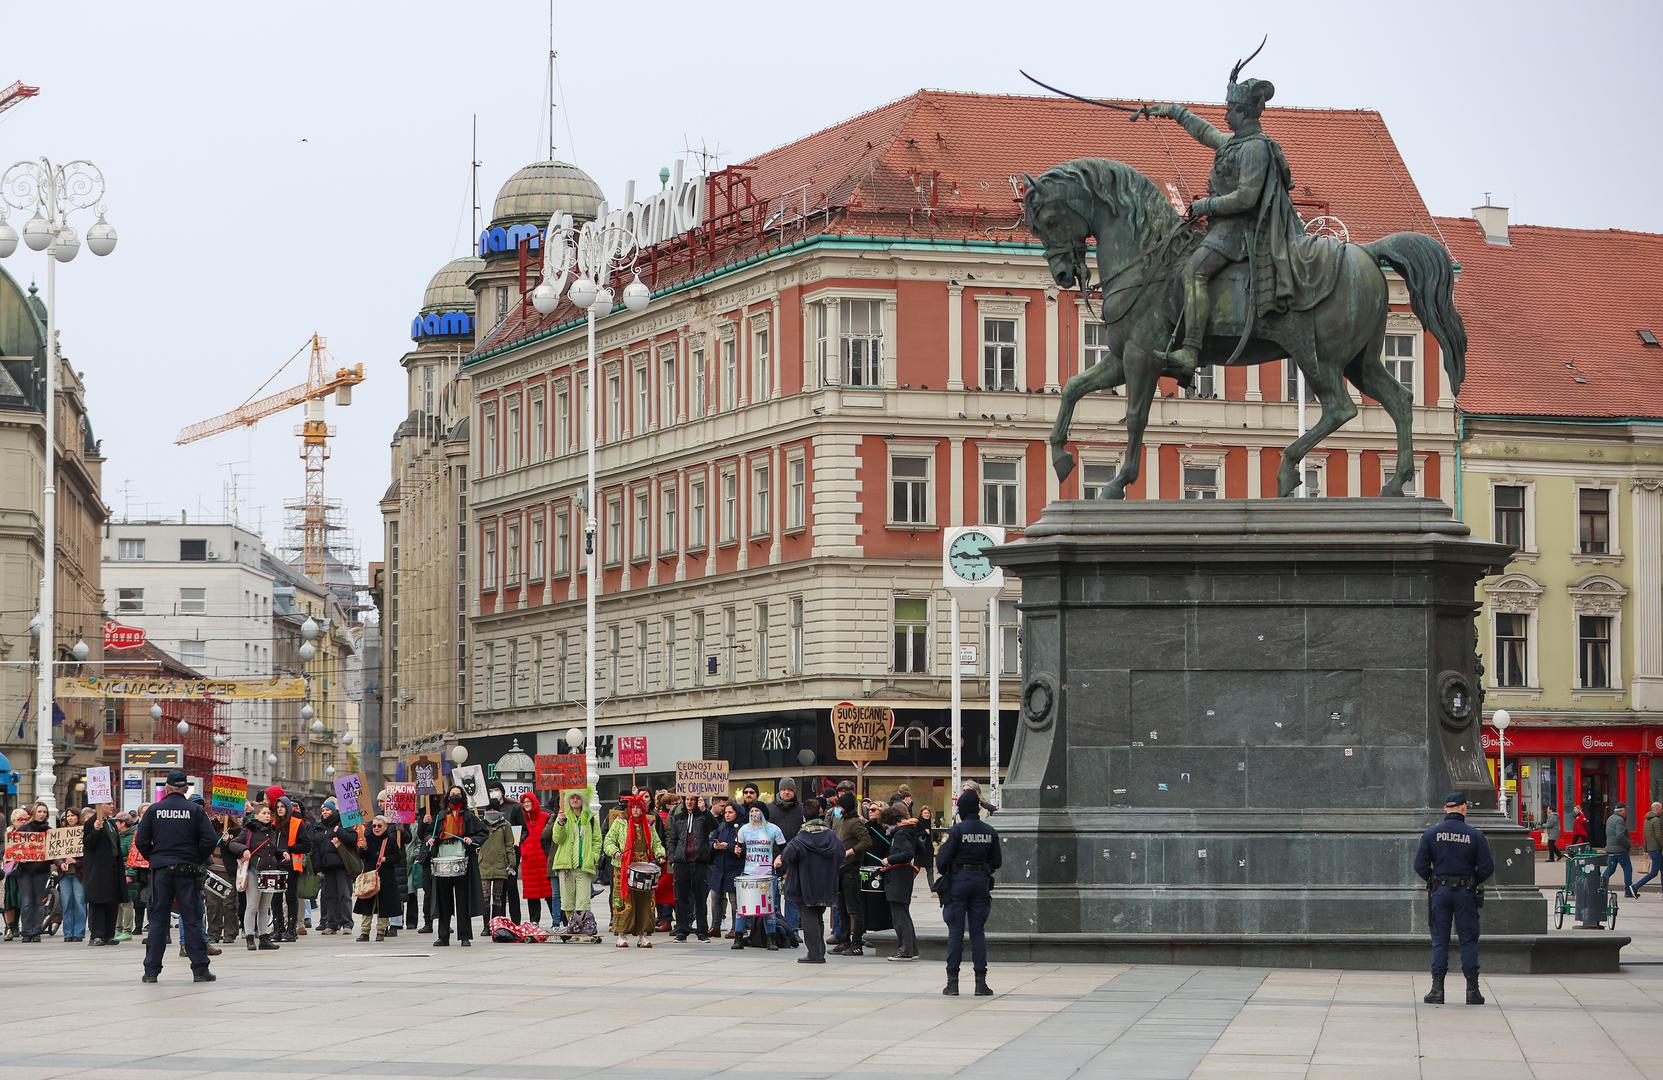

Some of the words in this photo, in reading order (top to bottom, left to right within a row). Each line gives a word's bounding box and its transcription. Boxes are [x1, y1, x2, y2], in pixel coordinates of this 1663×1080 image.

[838, 721, 887, 737] EMPATIJA
[761, 728, 791, 751] ZAKS
[838, 735, 847, 750] &
[848, 736, 887, 751] RAZUM
[1593, 739, 1614, 747] Diona
[342, 777, 361, 792] VAŠ
[676, 782, 687, 793] NE
[156, 809, 191, 819] POLICIJA
[50, 832, 60, 840] MI
[1436, 832, 1471, 844] POLICIJA
[49, 838, 74, 850] KRIVE
